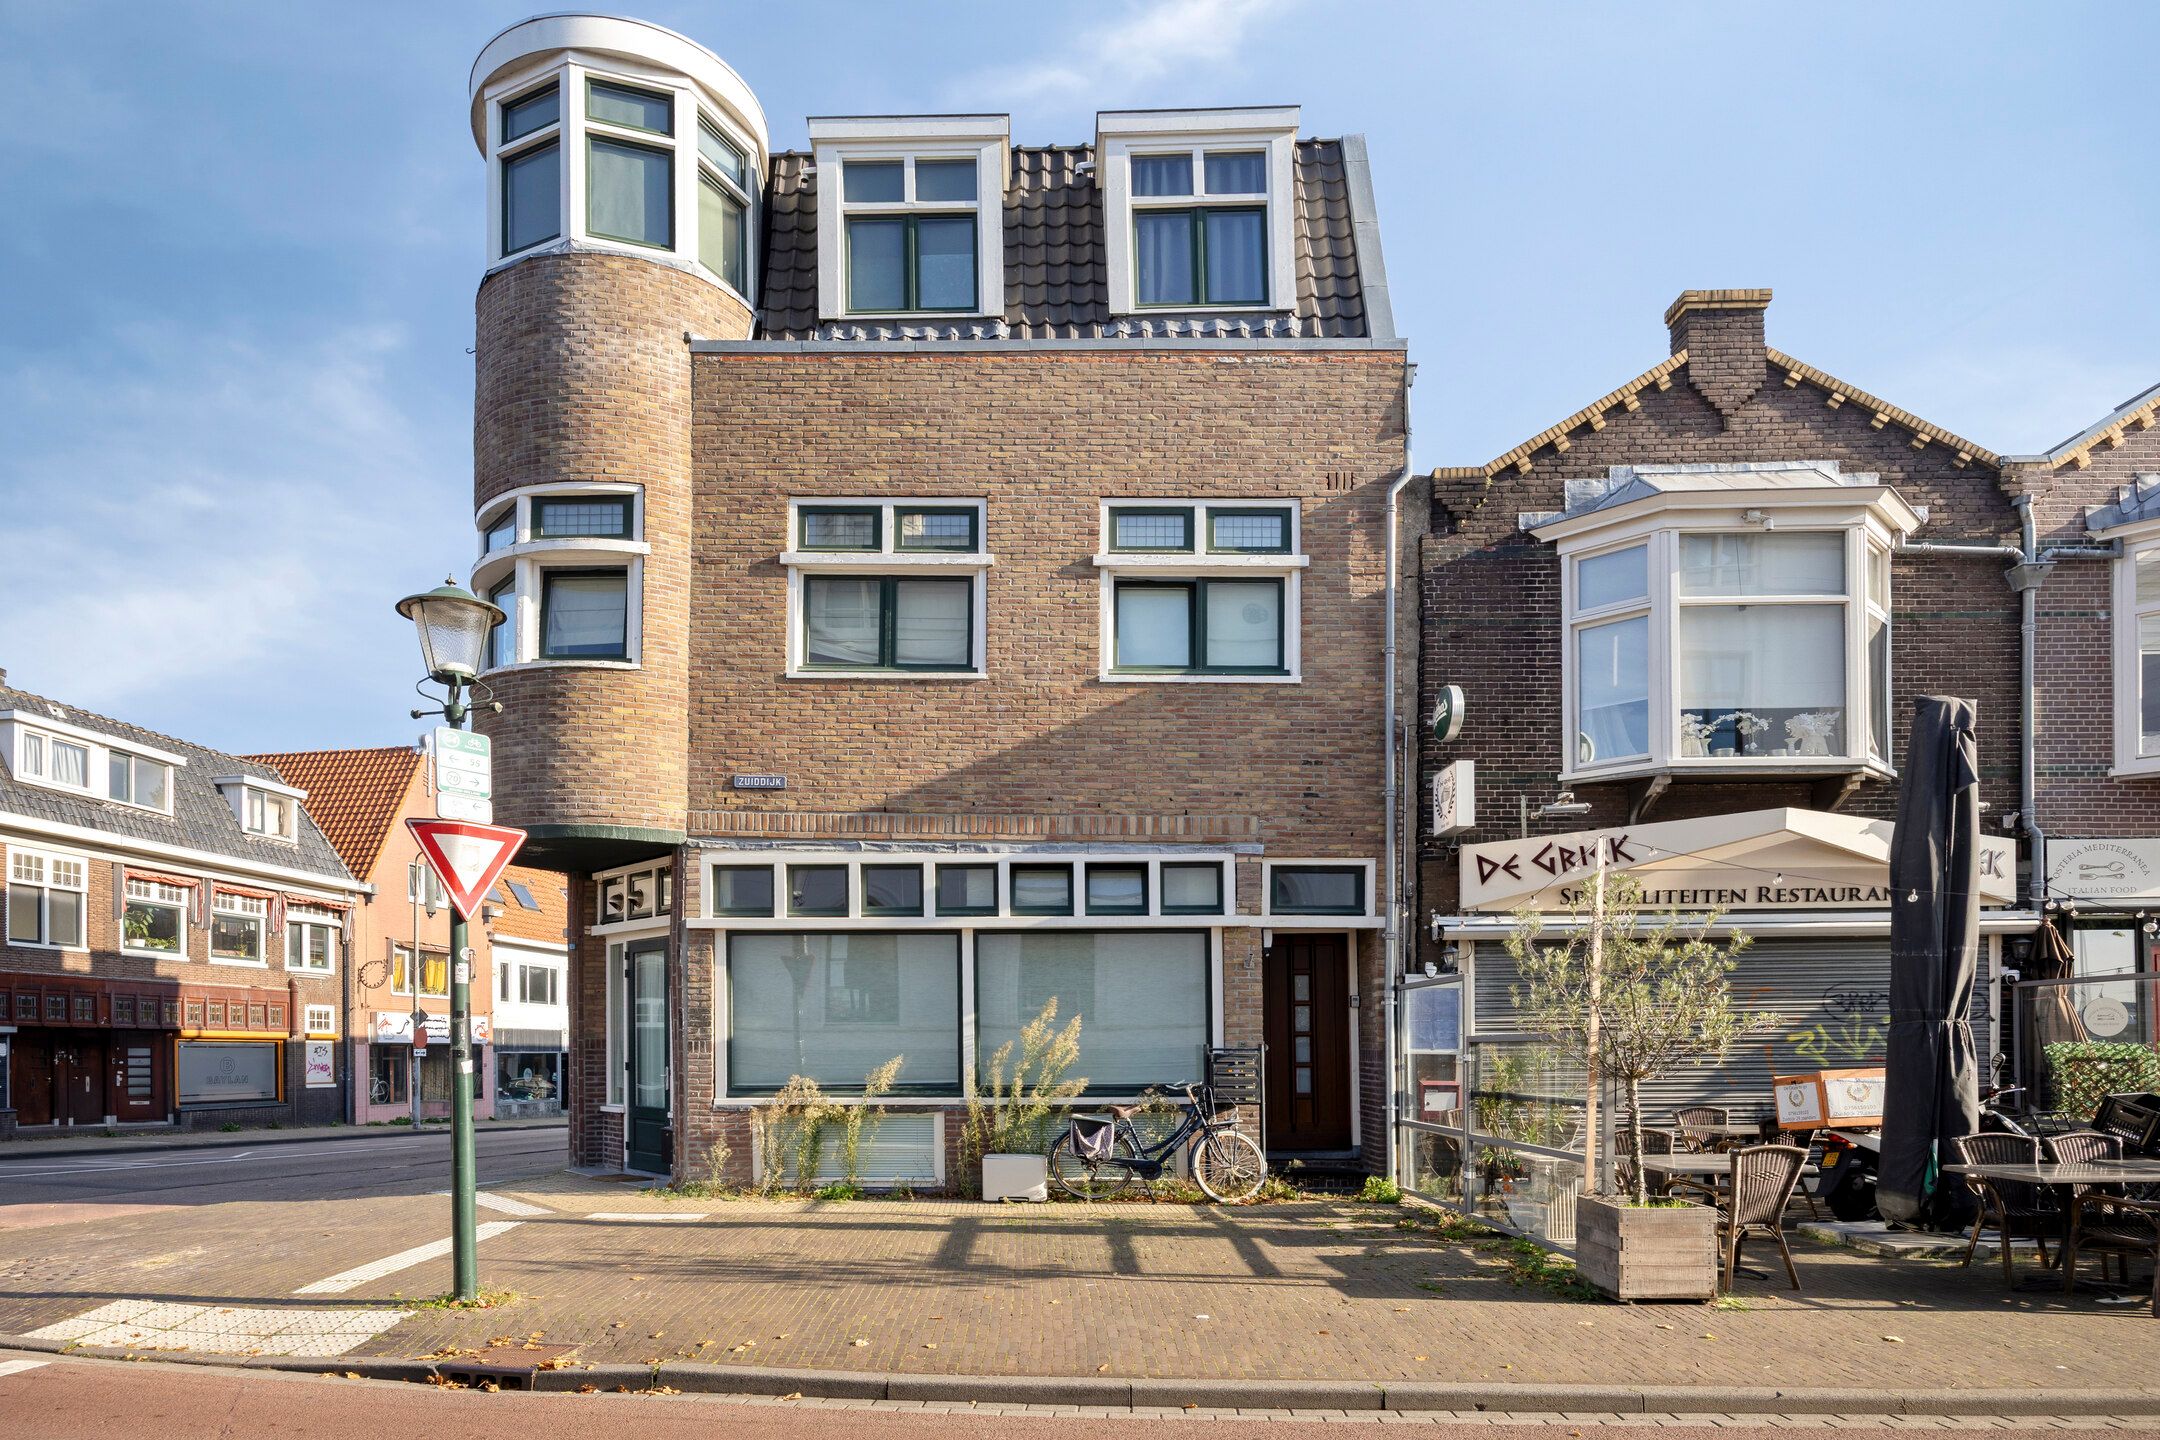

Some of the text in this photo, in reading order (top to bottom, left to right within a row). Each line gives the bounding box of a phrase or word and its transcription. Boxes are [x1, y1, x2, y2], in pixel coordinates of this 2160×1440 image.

[738, 777, 782, 786] ZUIDDIJK
[1475, 853, 1522, 886] DE
[2052, 843, 2151, 880] OSTERIA MEDITERRANEA
[2110, 886, 2137, 894] FOOD
